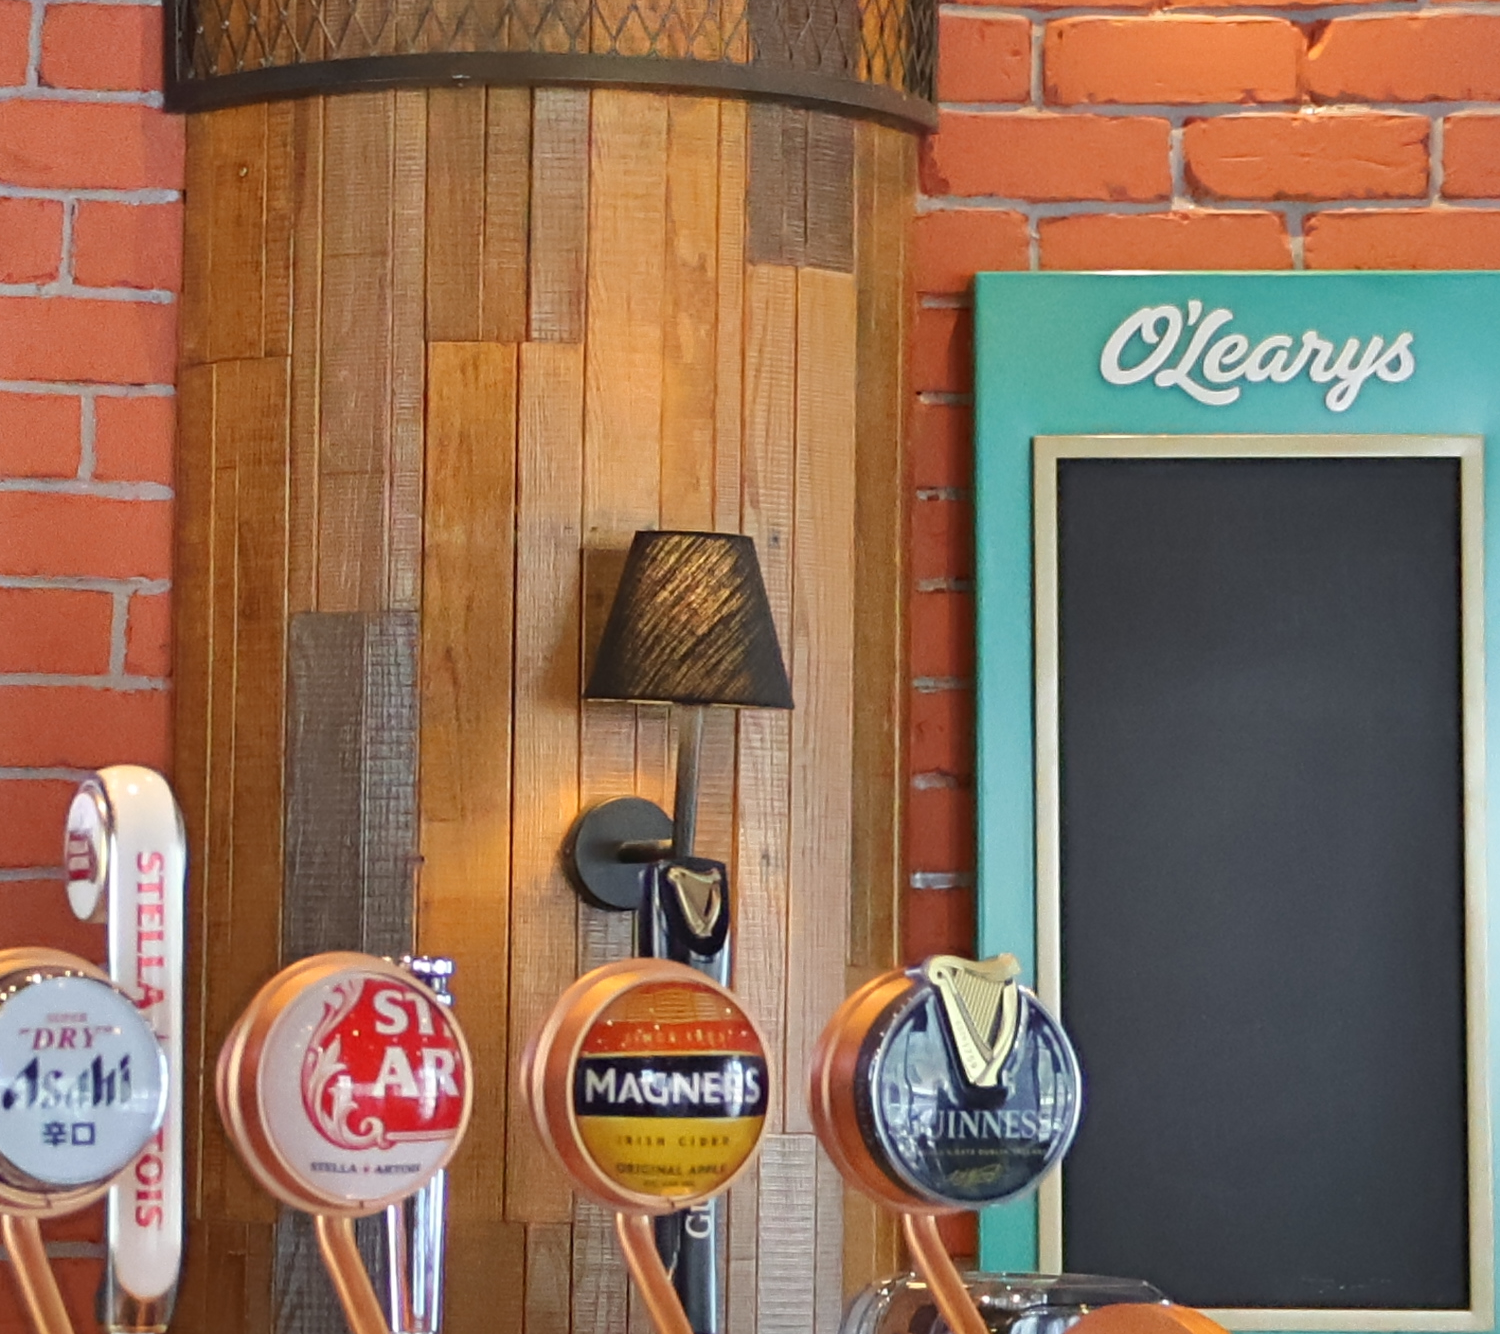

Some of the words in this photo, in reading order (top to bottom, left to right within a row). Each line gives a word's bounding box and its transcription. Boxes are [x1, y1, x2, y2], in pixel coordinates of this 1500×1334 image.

[1100, 299, 1415, 412] O'Learys
[135, 852, 166, 1012] STELLA
[2, 1054, 132, 1110] Asahi
[584, 1067, 762, 1106] MAGNERS
[43, 1122, 96, 1147] 辛口
[678, 1134, 731, 1147] CIDER
